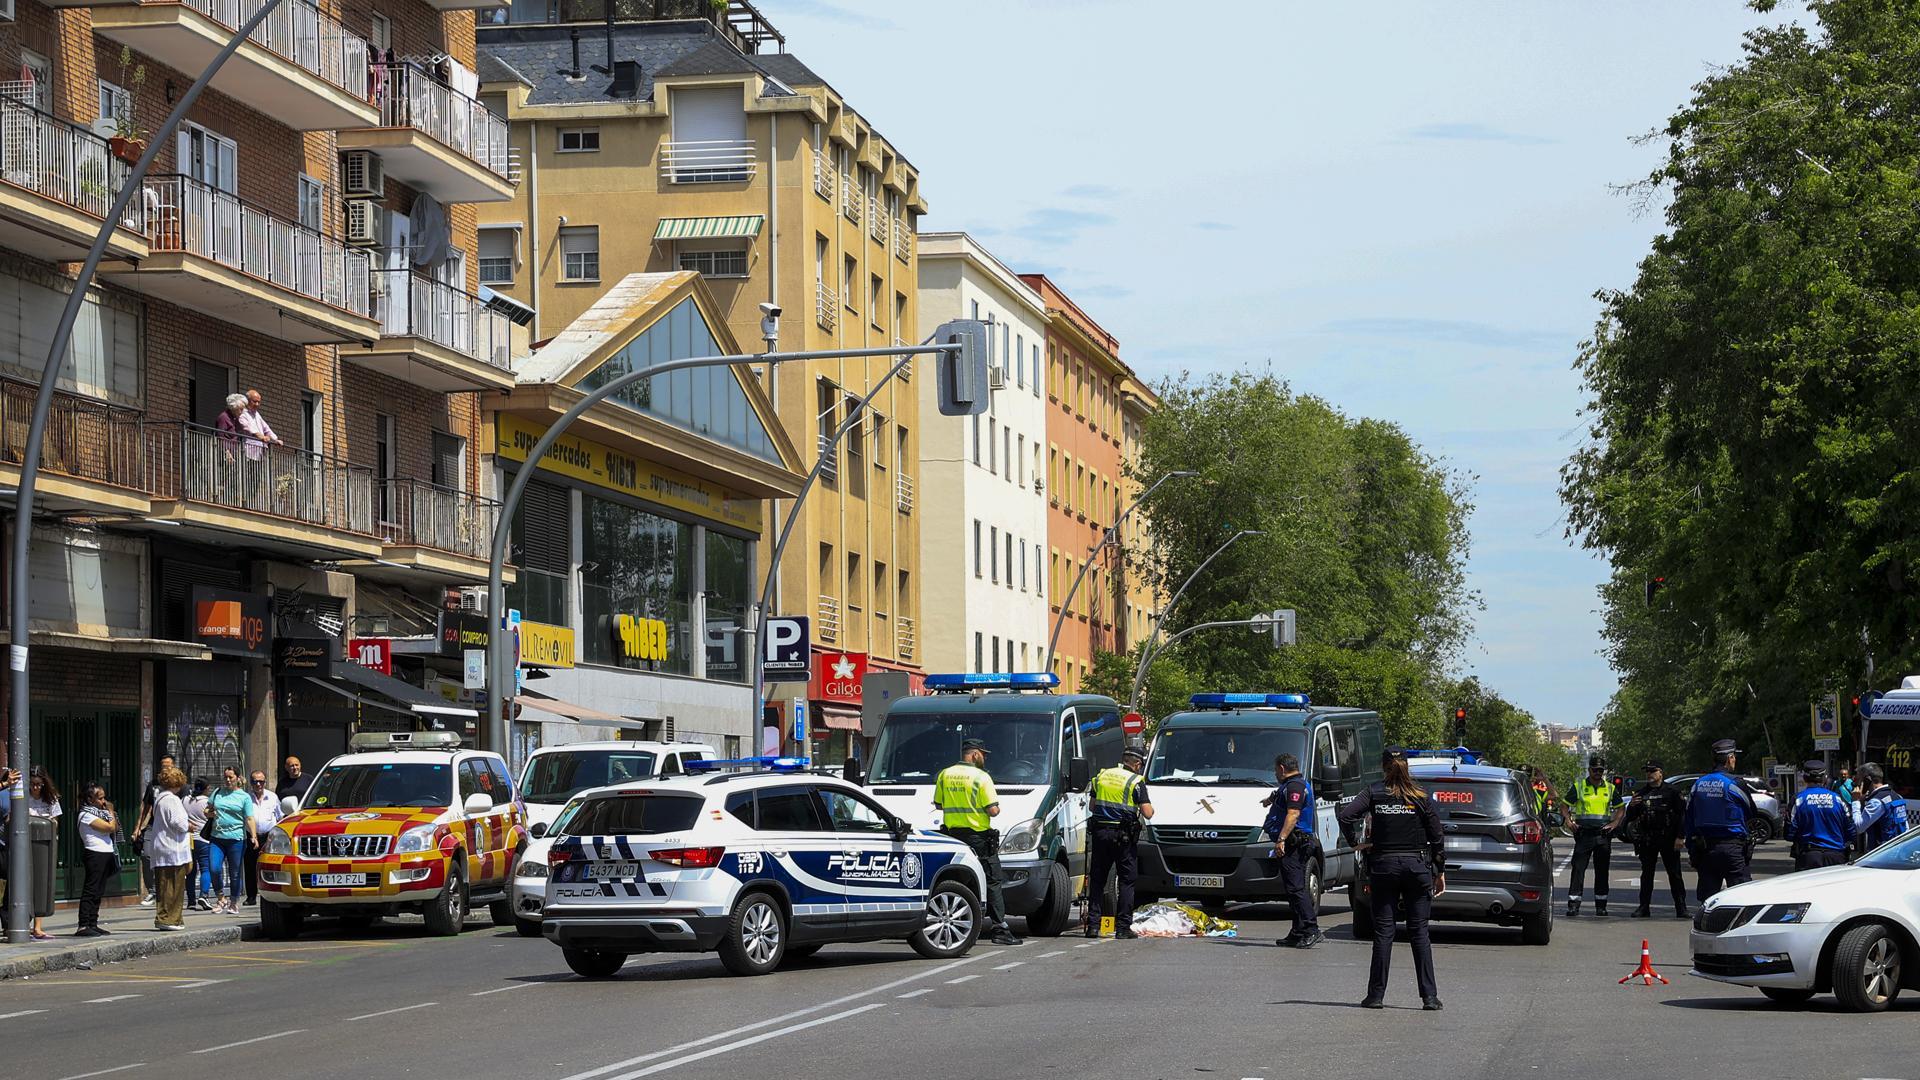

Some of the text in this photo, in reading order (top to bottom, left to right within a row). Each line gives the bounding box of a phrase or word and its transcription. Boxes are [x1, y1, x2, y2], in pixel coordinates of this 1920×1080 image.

[514, 430, 591, 470] supemercados
[199, 626, 227, 635] orange
[231, 615, 263, 650] nge
[462, 630, 482, 646] COMPRO
[767, 620, 801, 661] P
[826, 682, 863, 697] Gilgo
[1871, 704, 1920, 715] DE ACCIDENT
[1891, 750, 1910, 768] 112
[1433, 792, 1473, 804] TRAFICO
[1185, 831, 1218, 839] IVECO
[828, 853, 900, 871] POLICÍA
[589, 864, 635, 877] 5437 MCD
[738, 863, 755, 874] 112
[871, 870, 900, 878] MADRID
[318, 874, 364, 884] 4112 FZL
[1179, 877, 1196, 886] PGC
[1197, 877, 1218, 886] 1206
[556, 886, 602, 898] POLICÍA
[1104, 918, 1110, 928] 3
